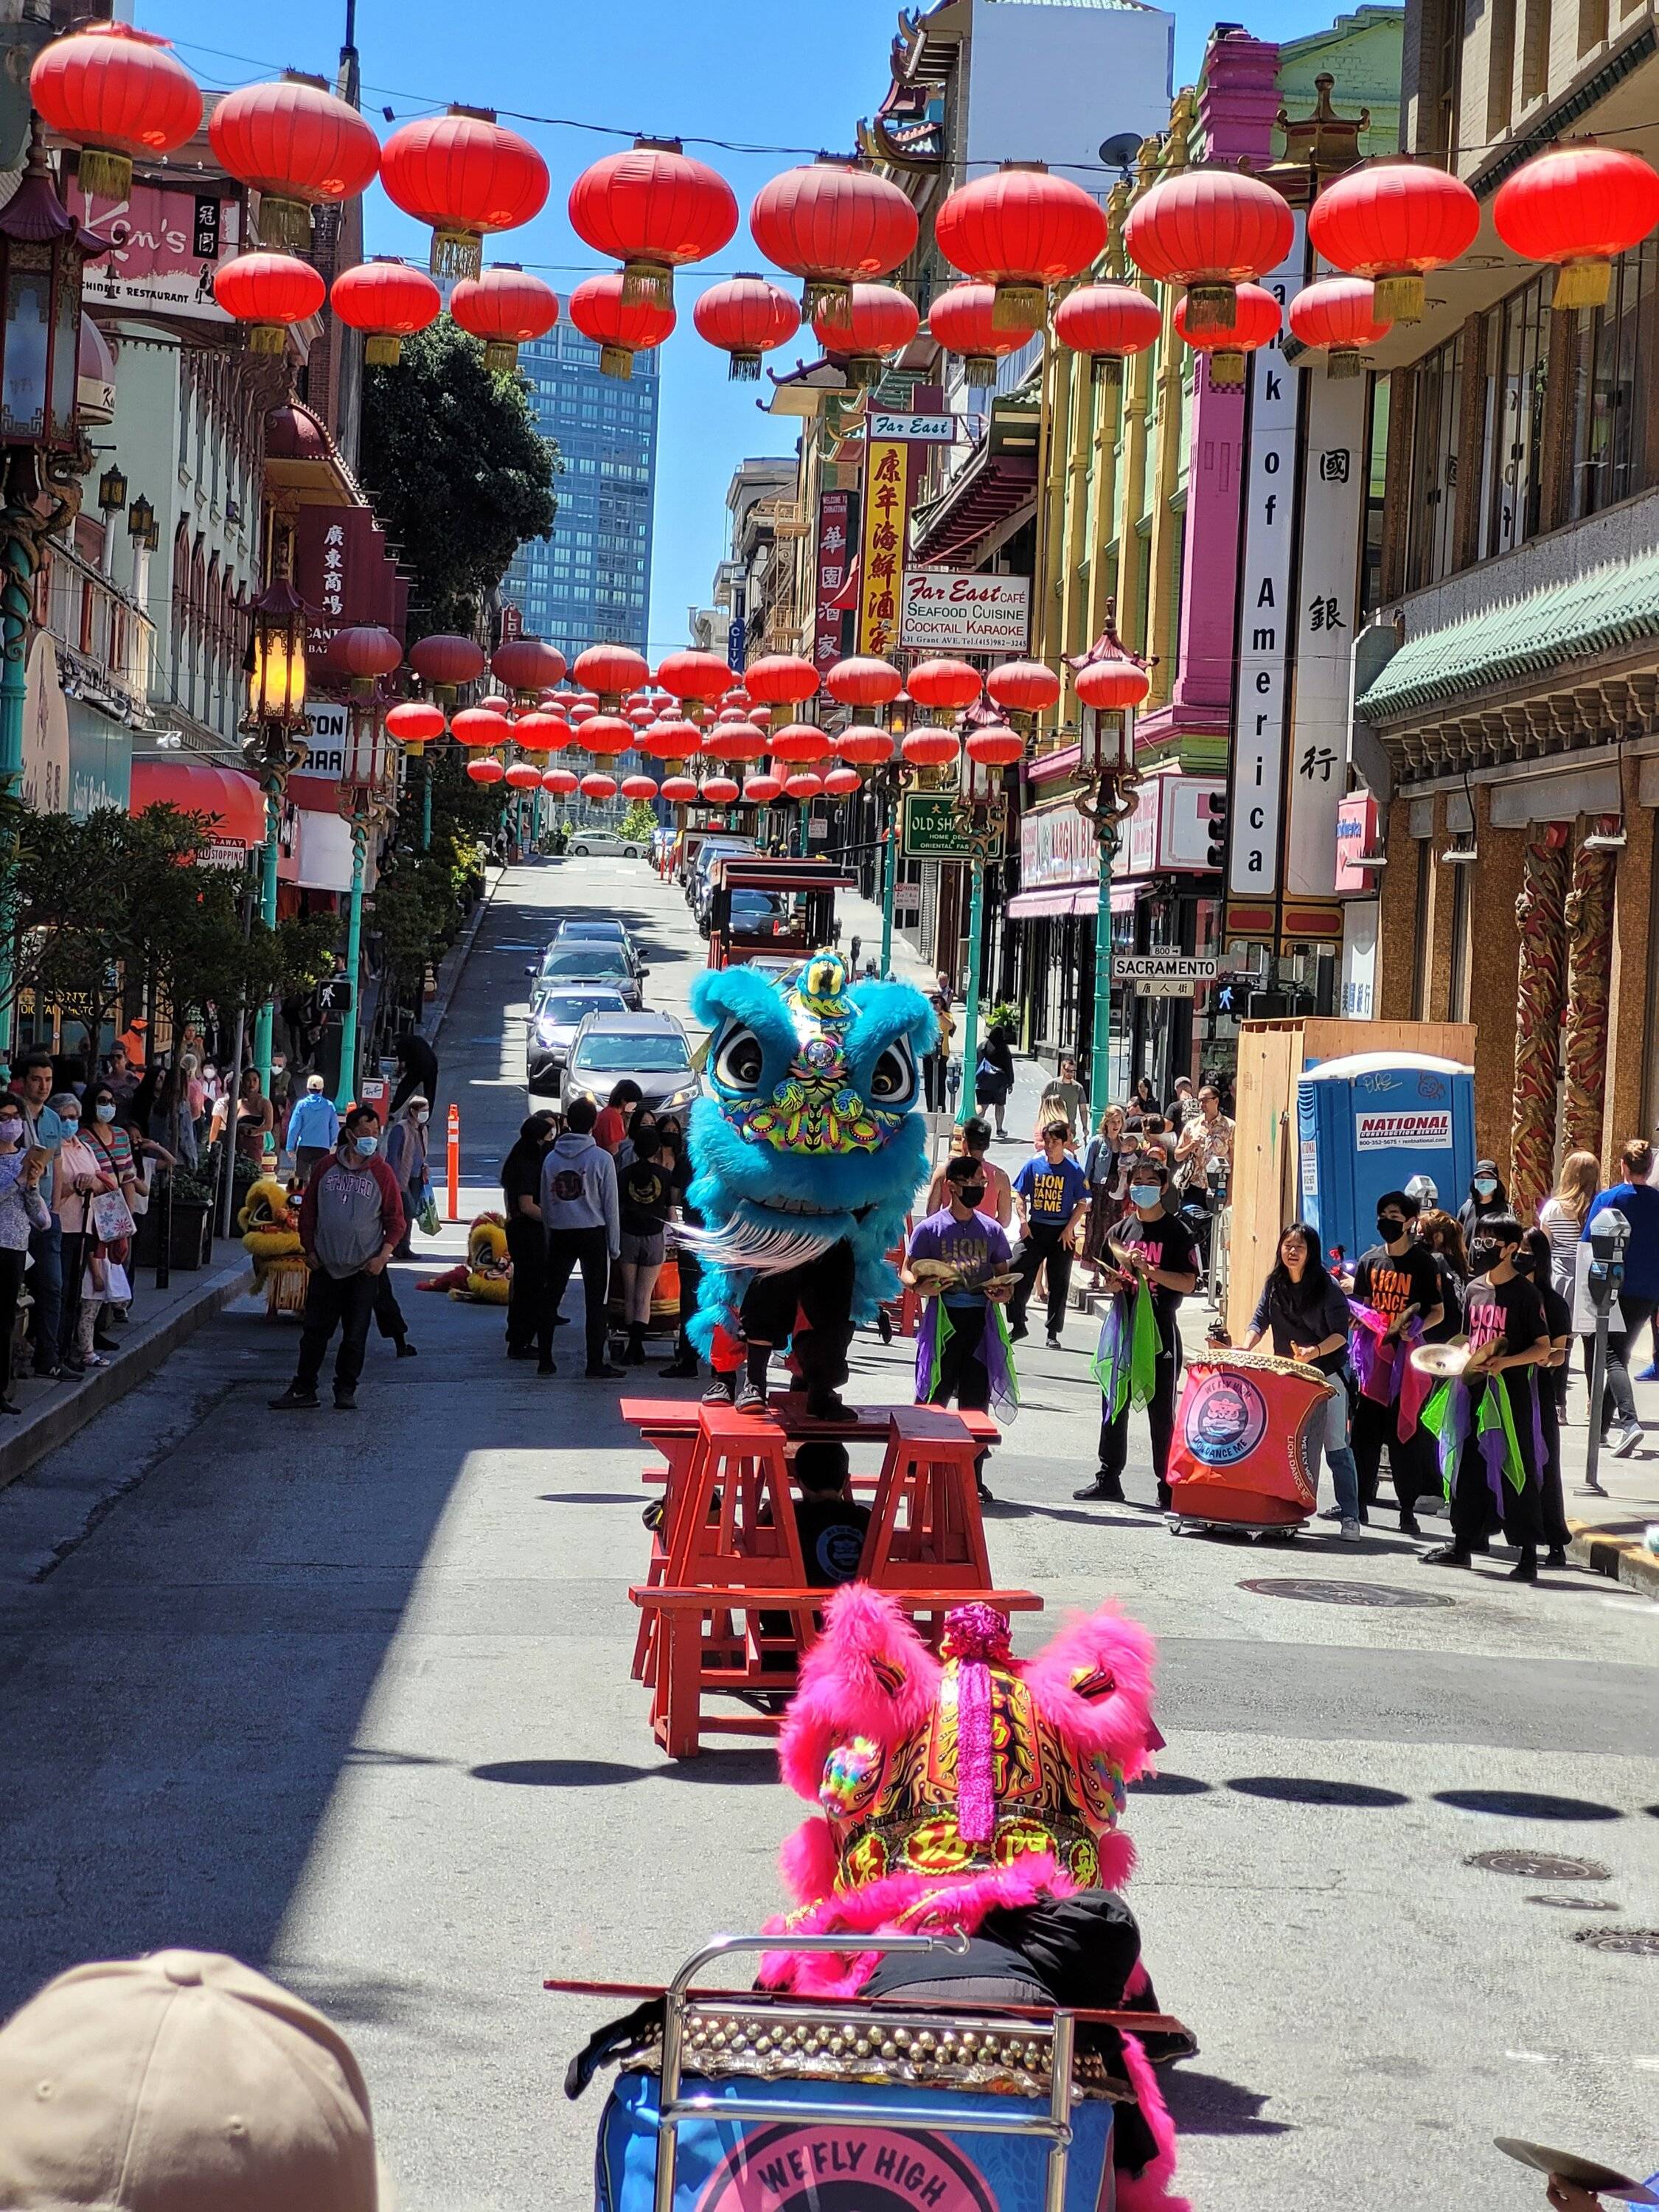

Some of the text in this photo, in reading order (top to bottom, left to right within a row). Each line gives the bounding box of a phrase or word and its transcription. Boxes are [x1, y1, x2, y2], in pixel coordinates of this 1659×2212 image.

[82, 281, 189, 303] CHINEE RESTAURANT
[876, 416, 947, 434] Far East
[1265, 451, 1280, 526] of
[322, 524, 344, 615] 廣東商場
[907, 577, 1026, 604] Far East CAFÉ
[908, 602, 1024, 620] SEAFOOD CUISINE
[306, 627, 341, 639] CANT
[905, 618, 1024, 636] COCKTAIL KARAOKE
[730, 627, 740, 667] CITY
[902, 635, 914, 643] 631
[917, 636, 939, 644] Grant
[1248, 577, 1275, 872] America
[912, 816, 934, 831] OLD
[212, 849, 243, 861] STOPPING
[1116, 961, 1214, 975] SACRAMENTO
[1142, 983, 1188, 994] 唐人街
[1361, 1116, 1448, 1131] NATIONAL
[1360, 1130, 1415, 1138] CONSTRUCTION
[325, 1174, 373, 1199] STANFORD
[1034, 1173, 1065, 1190] LION
[1034, 1188, 1063, 1201] DANCE
[1044, 1200, 1062, 1213] ME
[1371, 1267, 1413, 1296] LION
[1372, 1292, 1409, 1312] ANCE
[1470, 1304, 1508, 1330] LION
[1205, 1447, 1233, 1458] DANCE
[1233, 1438, 1248, 1454] ME
[757, 2140, 948, 2208] WE FLY HIGH
